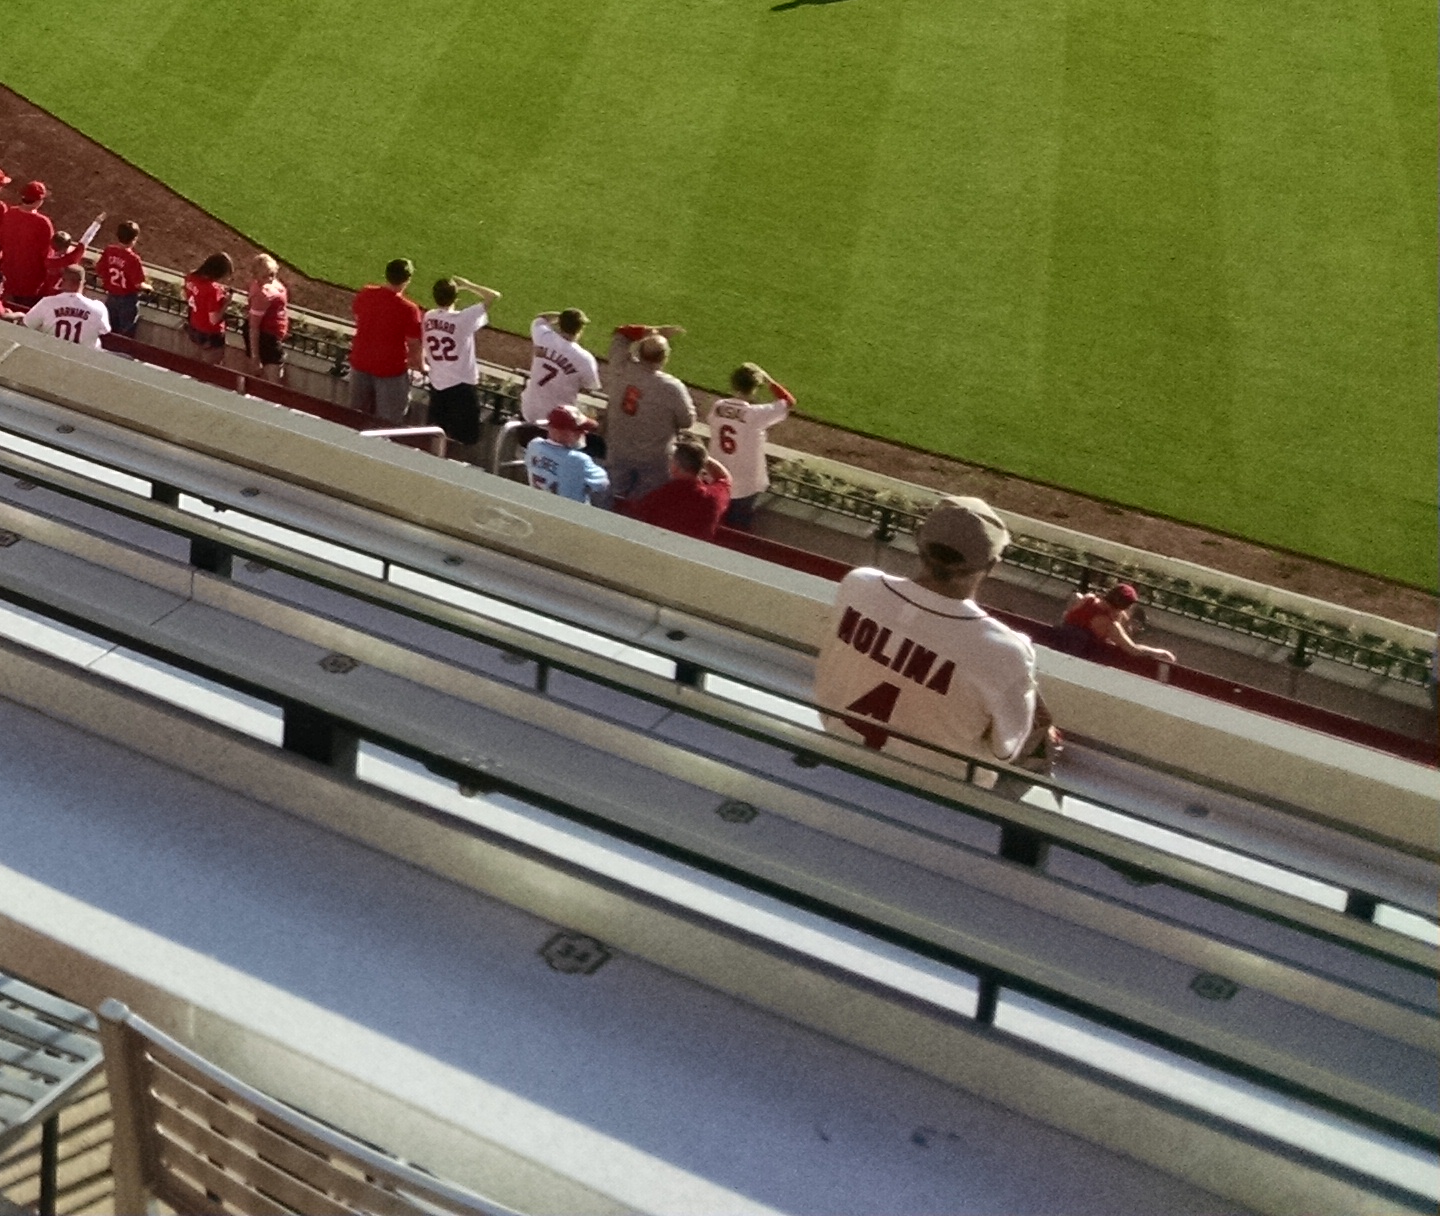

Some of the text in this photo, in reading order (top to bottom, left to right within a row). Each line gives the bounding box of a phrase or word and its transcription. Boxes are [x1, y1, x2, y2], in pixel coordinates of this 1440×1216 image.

[109, 267, 128, 289] 21
[426, 336, 459, 362] 22
[537, 363, 559, 387] 7
[719, 424, 737, 455] 6
[837, 606, 956, 695] MOLINA
[842, 681, 901, 750] 4
